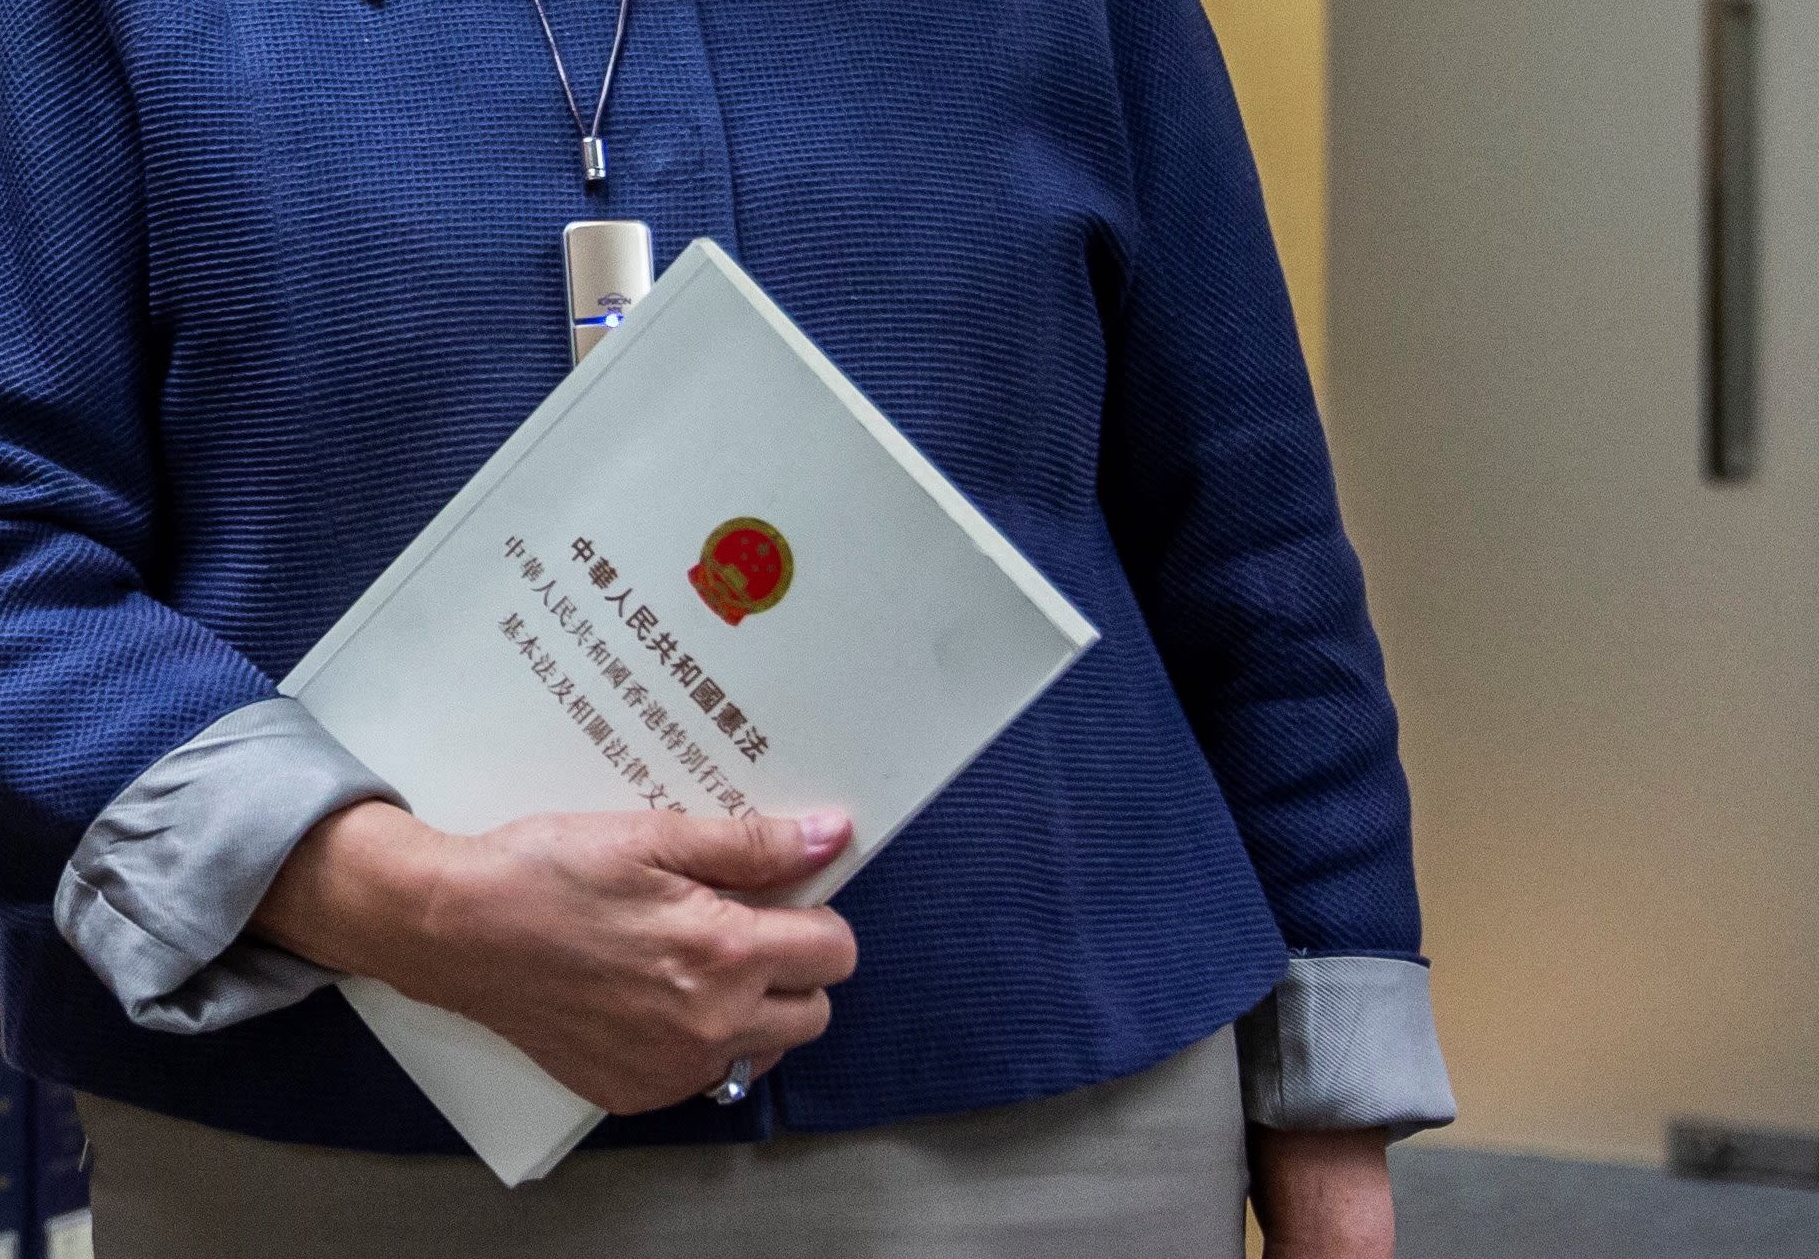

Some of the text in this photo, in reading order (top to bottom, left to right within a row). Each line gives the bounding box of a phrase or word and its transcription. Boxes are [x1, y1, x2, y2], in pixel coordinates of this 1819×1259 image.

[570, 536, 770, 763] 中華人民共和國憲法
